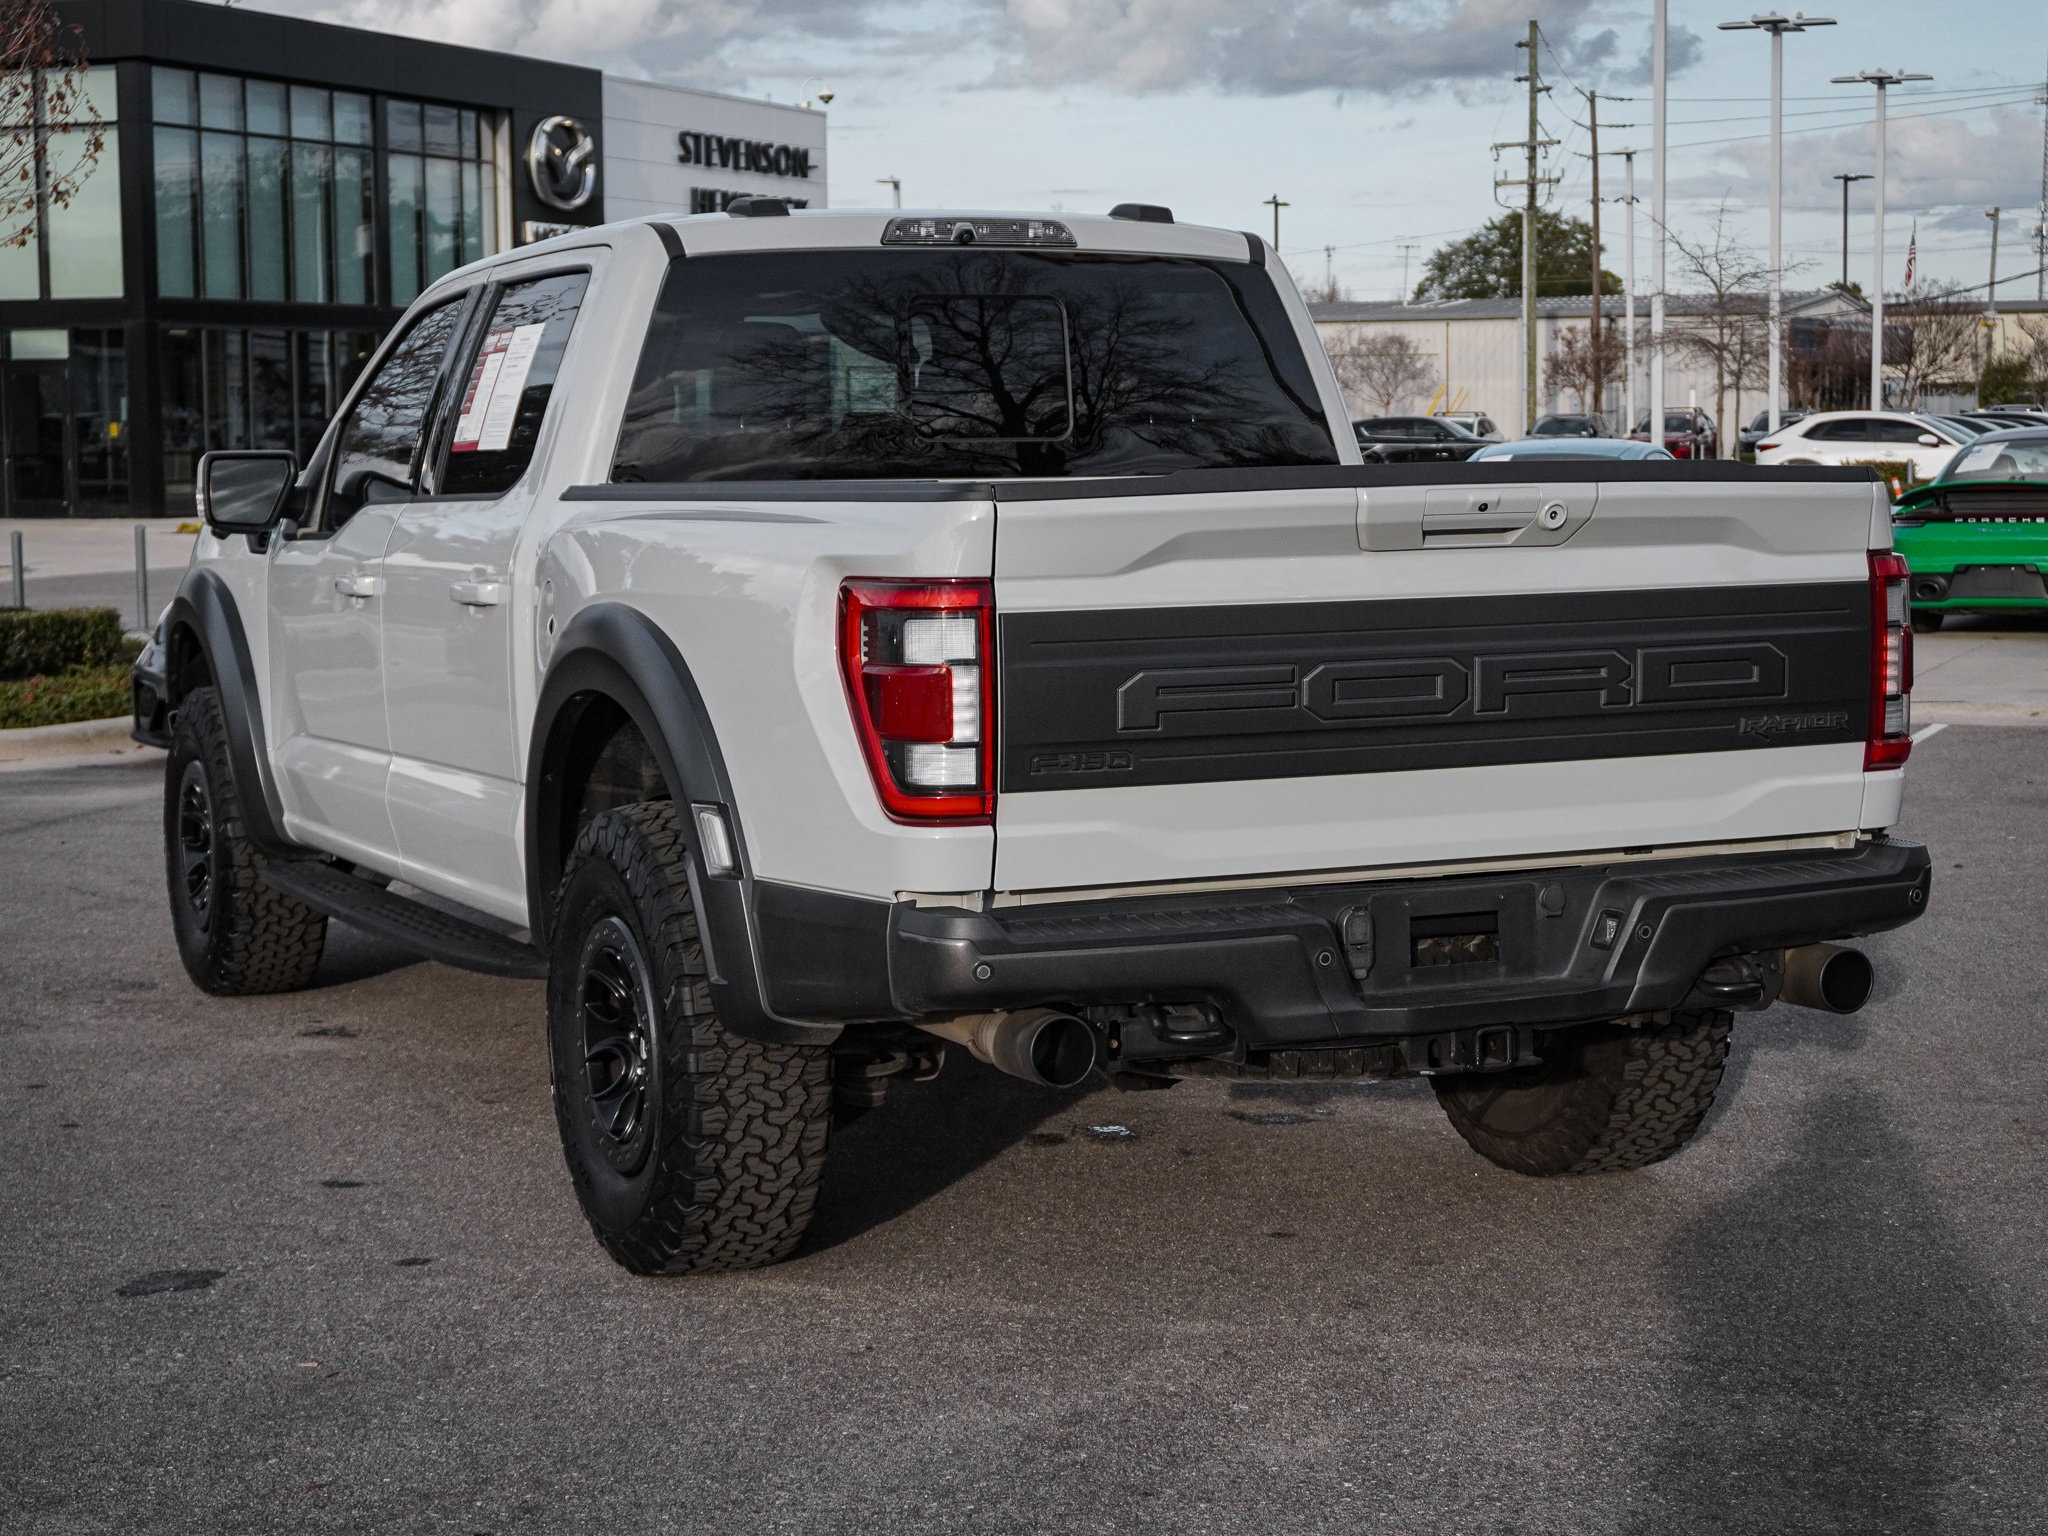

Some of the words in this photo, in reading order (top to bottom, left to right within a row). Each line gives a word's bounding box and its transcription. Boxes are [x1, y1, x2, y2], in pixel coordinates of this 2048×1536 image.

[1116, 641, 1788, 732] FORD
[1739, 711, 1855, 742] RAPTOR
[1030, 750, 1134, 776] F-150
